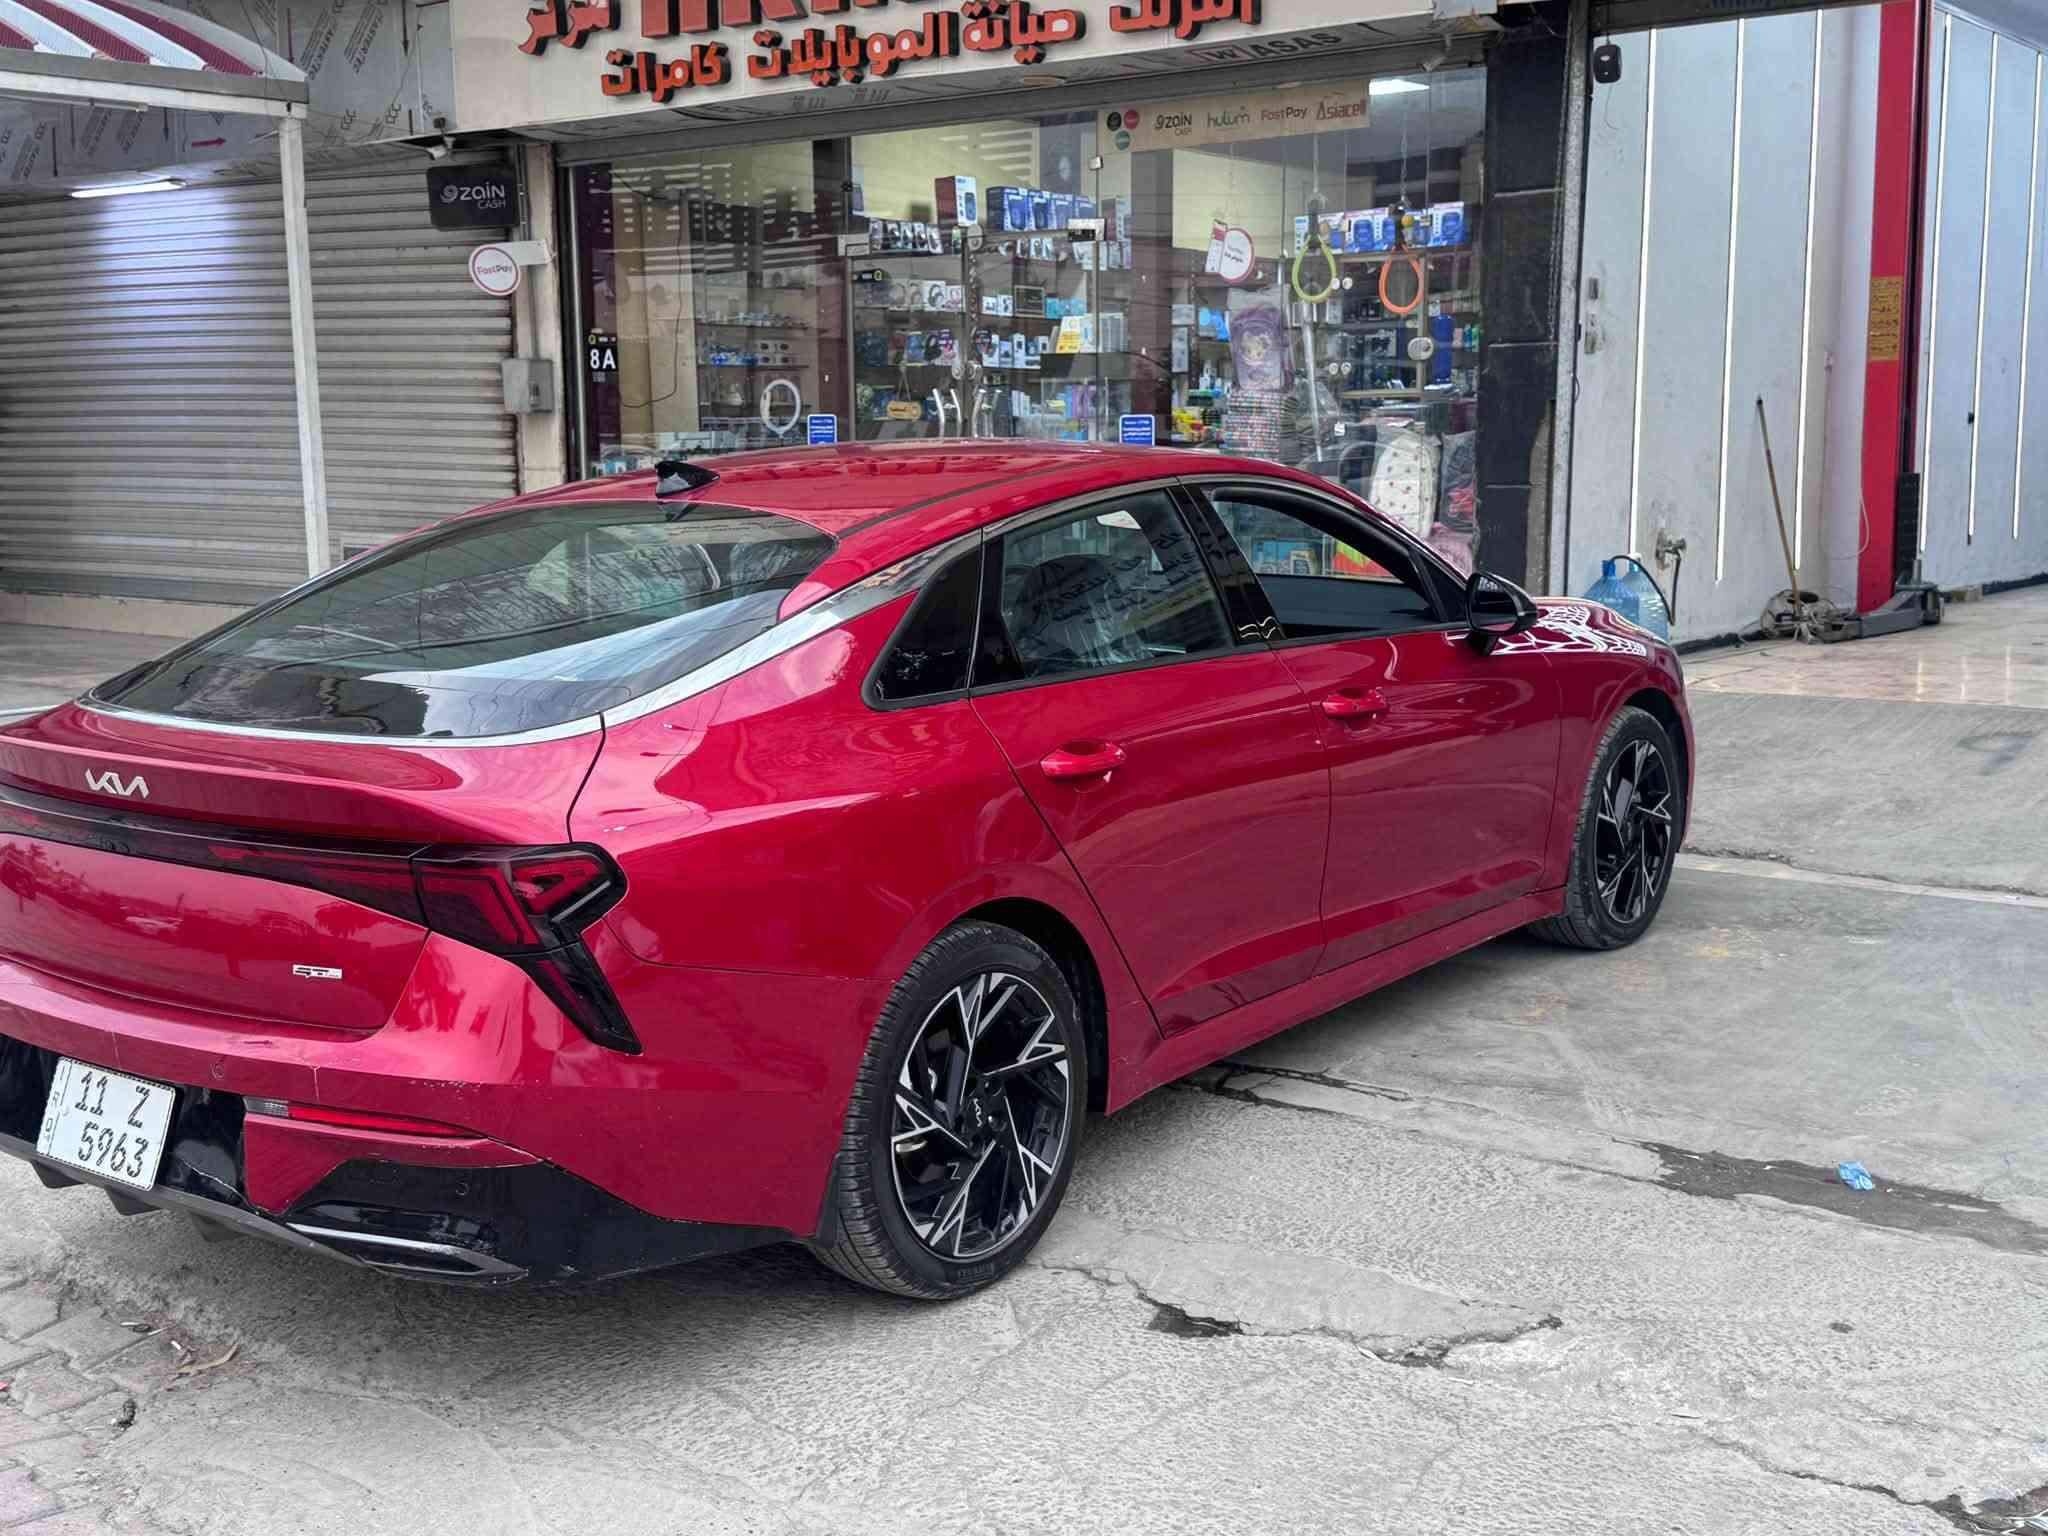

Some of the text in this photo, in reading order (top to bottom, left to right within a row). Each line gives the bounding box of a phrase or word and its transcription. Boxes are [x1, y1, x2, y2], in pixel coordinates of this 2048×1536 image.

[601, 41, 730, 103] كامرات
[85, 768, 150, 799] KIA
[74, 1070, 109, 1116] 11
[78, 1120, 149, 1178] 5963
